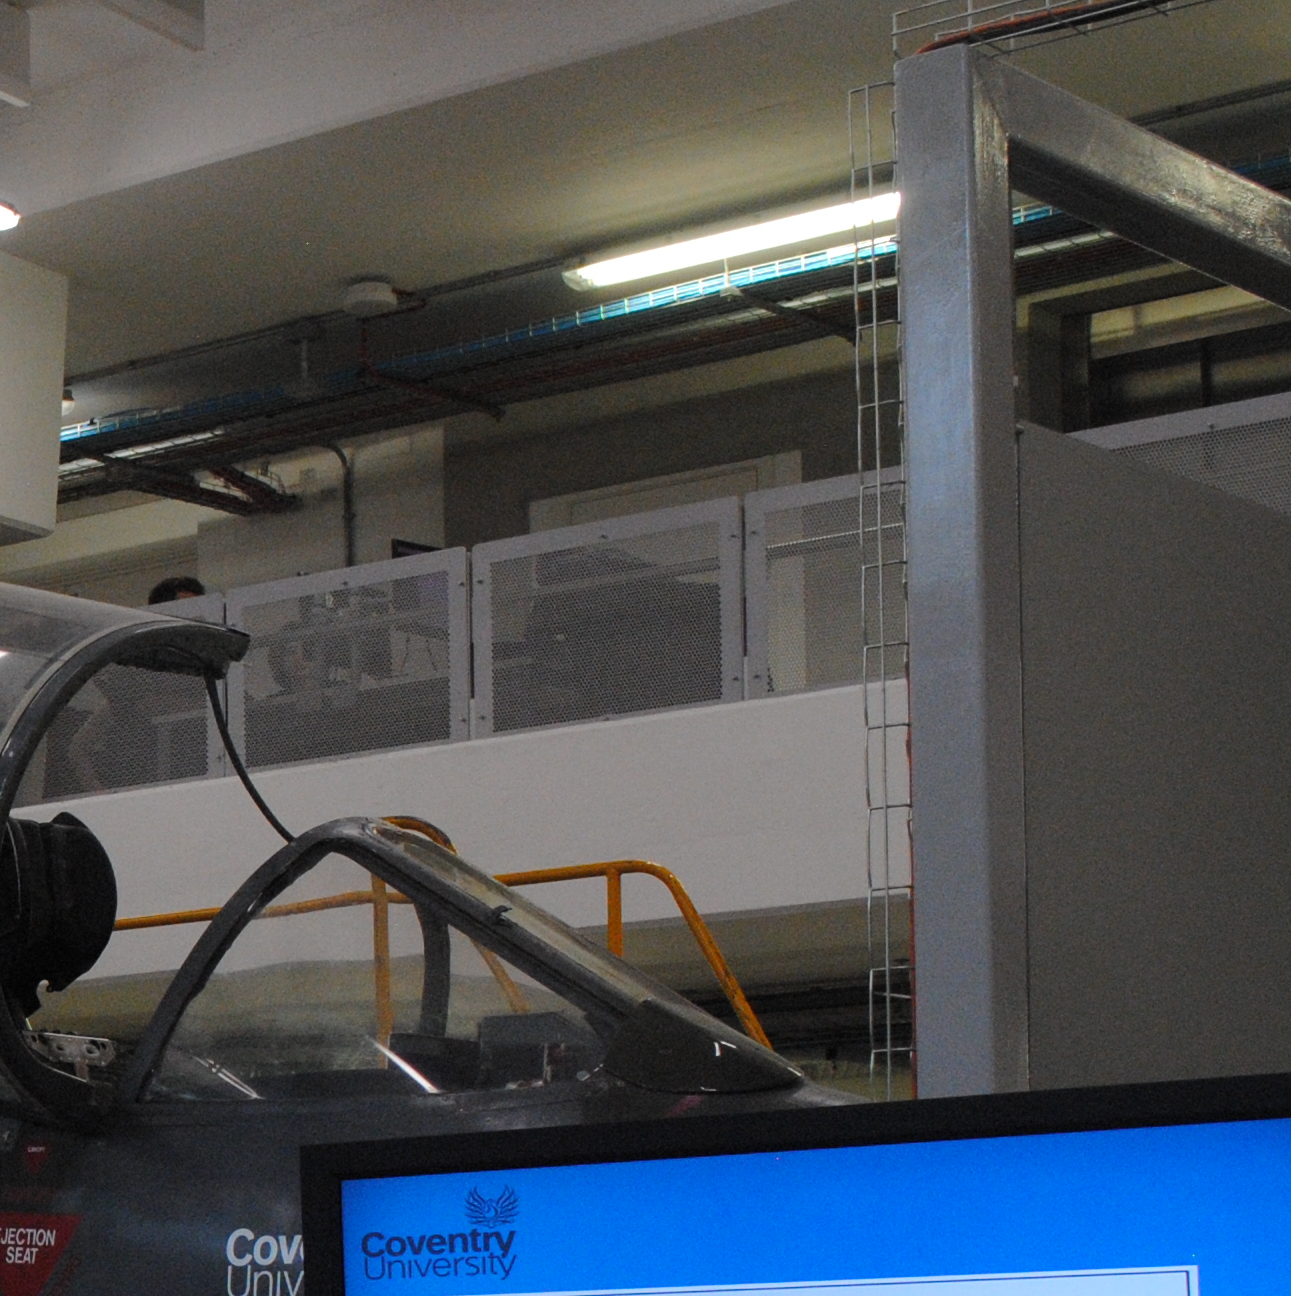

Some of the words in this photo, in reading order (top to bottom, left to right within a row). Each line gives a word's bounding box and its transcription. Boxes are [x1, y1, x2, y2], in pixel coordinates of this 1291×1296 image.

[5, 1246, 39, 1264] SEAT
[226, 1228, 304, 1267] Cov
[361, 1228, 516, 1259] Coventry
[364, 1252, 517, 1280] University
